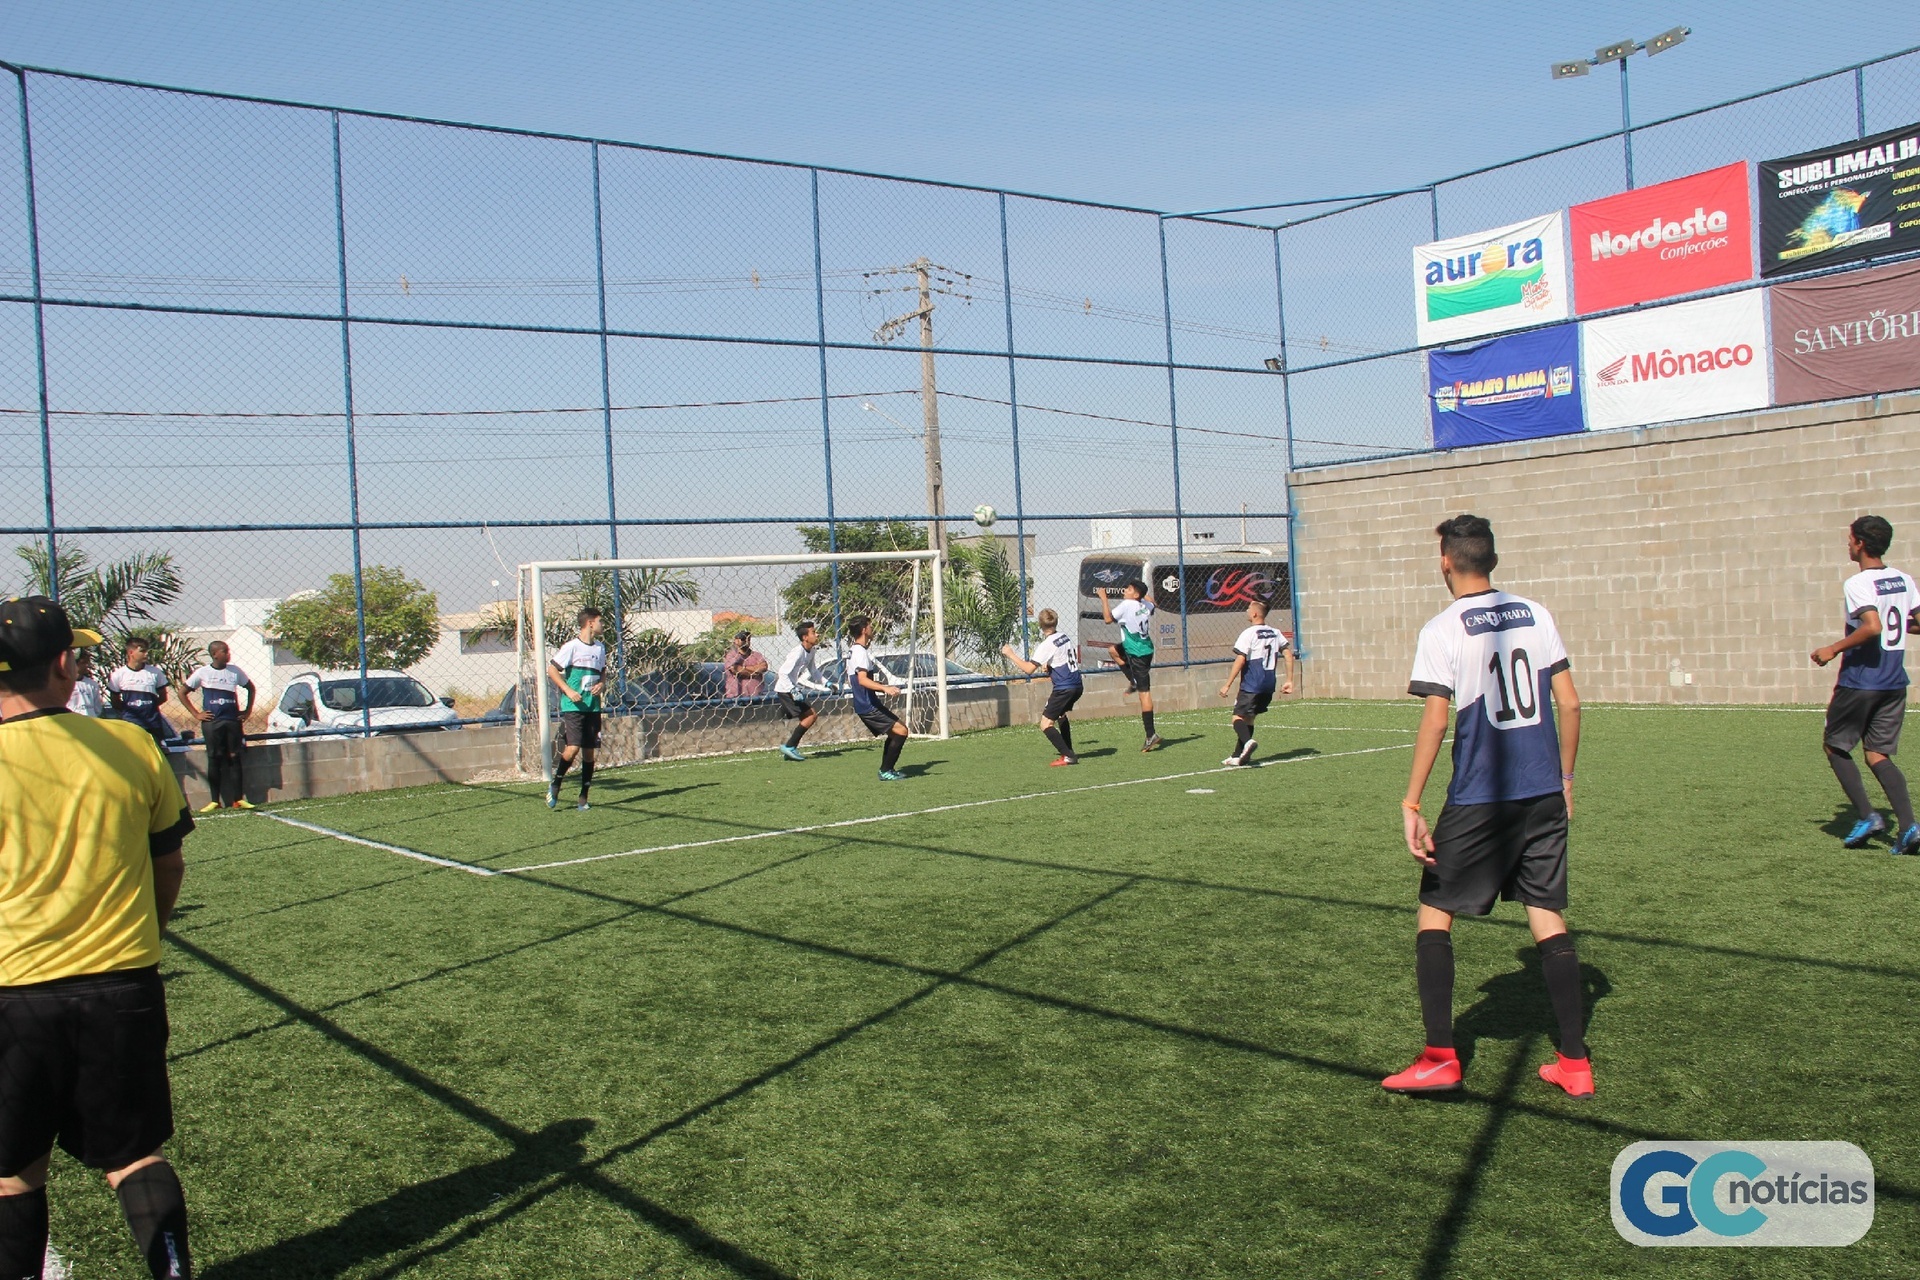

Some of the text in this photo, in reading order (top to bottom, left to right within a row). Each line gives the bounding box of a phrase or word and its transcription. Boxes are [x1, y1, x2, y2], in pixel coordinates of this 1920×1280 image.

[1778, 183, 1823, 199] CONFECÇÕES
[1830, 166, 1894, 187] PERSONALIZADOS
[1590, 207, 1727, 261] Nordeste
[1660, 235, 1728, 261] Confecções
[1631, 343, 1753, 382] Mônaco
[1460, 377, 1505, 398] BARATO
[1506, 369, 1547, 392] MANIA
[1597, 378, 1629, 388] HONDA
[1465, 609, 1531, 627] CASA PRADO
[1887, 606, 1902, 646] 9
[1264, 644, 1272, 668] 7
[1488, 648, 1536, 722] 10
